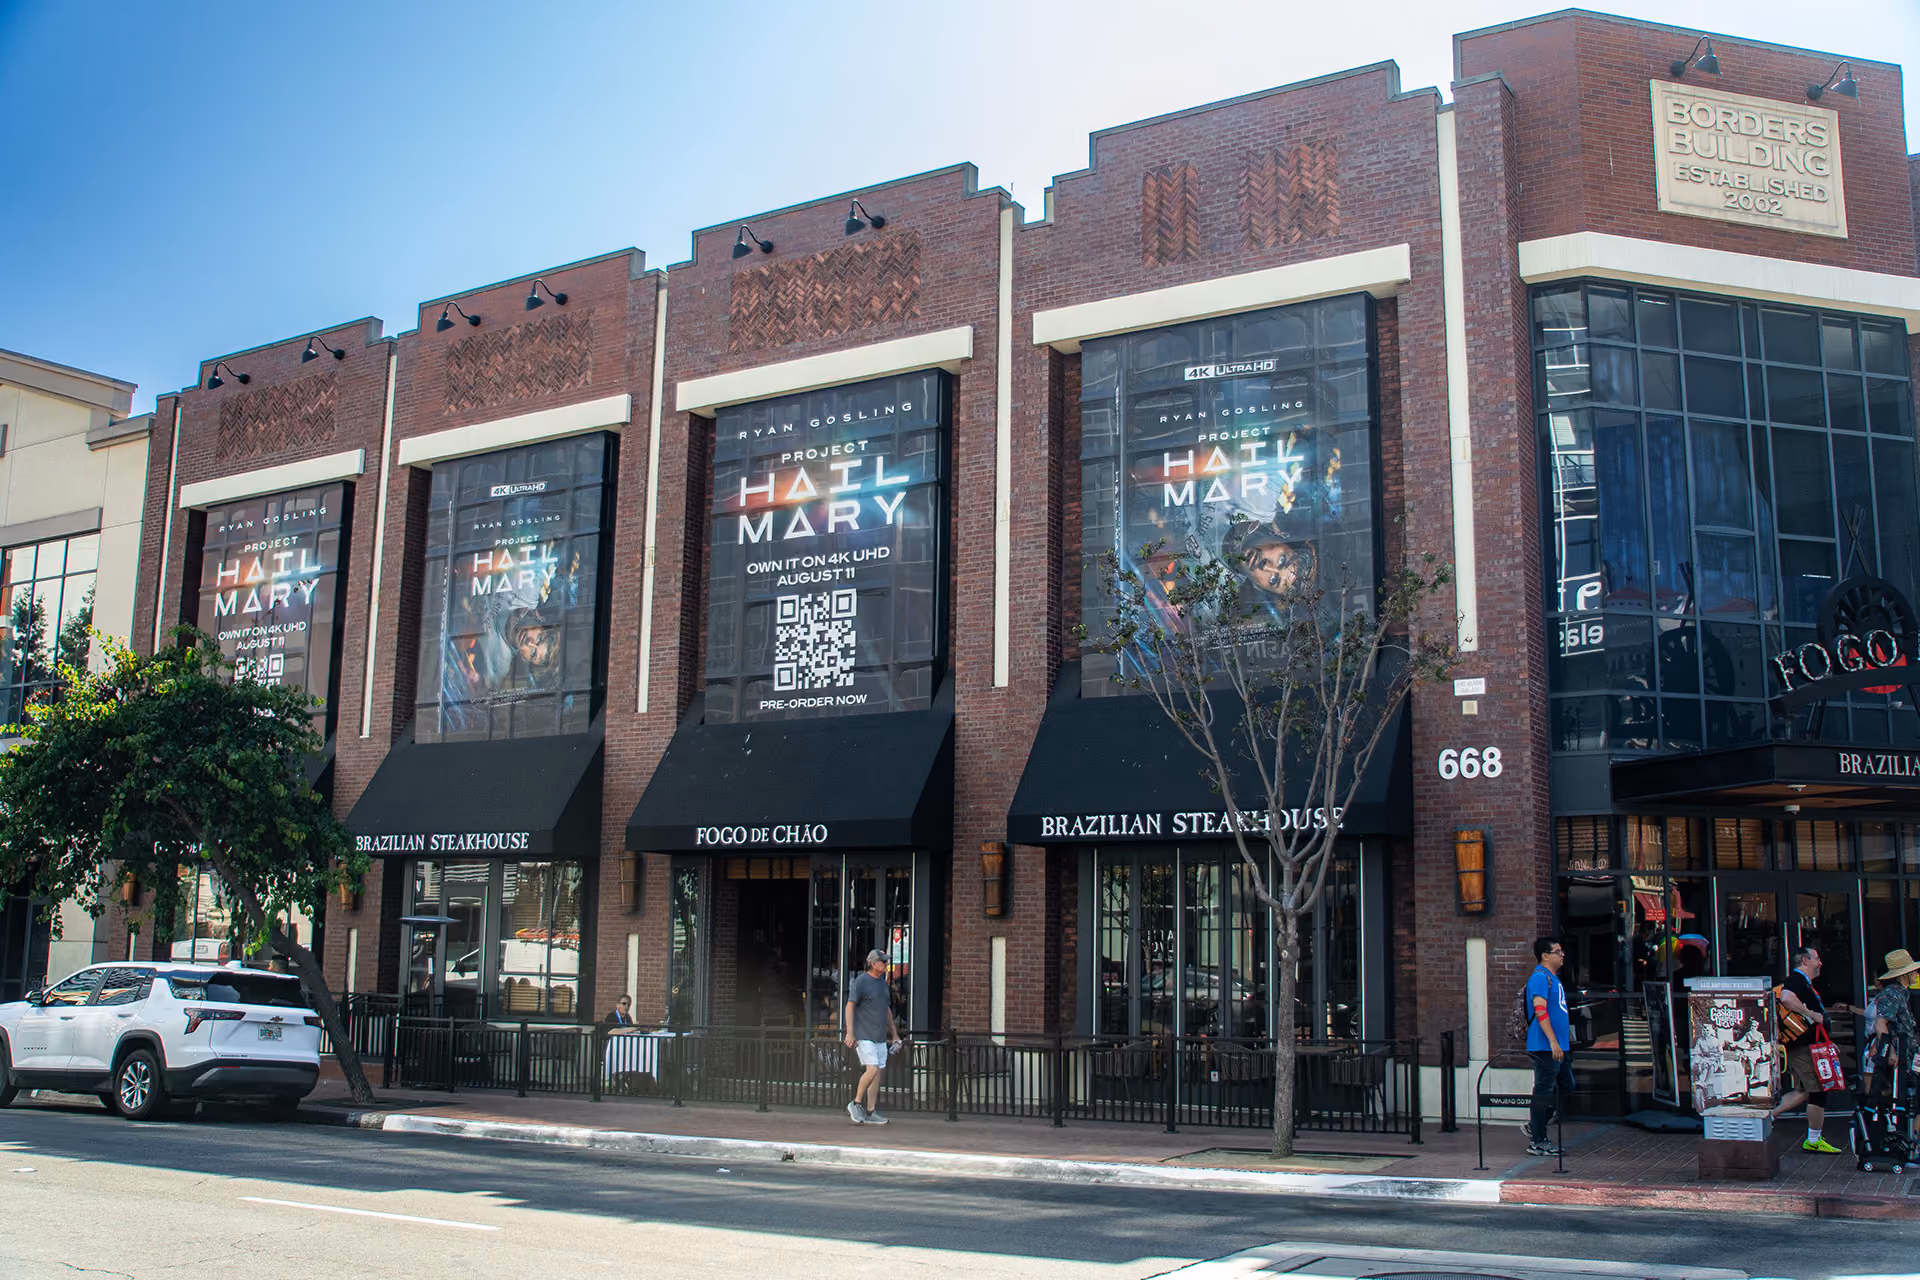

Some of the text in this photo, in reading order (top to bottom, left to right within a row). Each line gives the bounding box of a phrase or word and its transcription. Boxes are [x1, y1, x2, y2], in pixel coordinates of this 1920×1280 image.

[1667, 99, 1829, 148] BORDERS
[1668, 126, 1831, 177] BUILDING
[1674, 162, 1829, 203] ESTABLISHED
[1724, 191, 1784, 217] 2002
[1189, 367, 1210, 378] 4K
[740, 402, 914, 440] RYAN GOSLING
[1160, 401, 1303, 424] RYAN GOSLING
[1198, 426, 1271, 443] PROJECT
[782, 440, 869, 464] PROJECT
[1164, 439, 1304, 477] HAIL
[494, 487, 507, 495] 4K
[740, 455, 910, 507] HAIL
[1164, 467, 1304, 508] MARY
[219, 507, 327, 533] RYAN GOSLING
[474, 515, 561, 530] RYAN GOSLING
[738, 491, 907, 545] MARY
[244, 536, 298, 553] PROJECT
[495, 535, 540, 546] PROJECT
[217, 548, 321, 587] HAIL
[473, 545, 558, 573] HAIL
[747, 547, 890, 574] OWN IT ON 4K UHD
[472, 569, 555, 597] MARY
[776, 567, 856, 587] AUGUST 11
[214, 578, 320, 617] MARY
[218, 621, 306, 640] OWN IT ON 4K UHD
[236, 636, 285, 650] AUGUST 11
[1773, 629, 1898, 693] FOGO
[760, 694, 867, 710] PRE-ORDER NOW
[1438, 746, 1503, 780] 668
[696, 824, 828, 844] FOGO DE CHÃO
[1041, 813, 1161, 837] BRAZILIAN
[356, 832, 530, 851] BRAZILIAN STEAKHOUSE
